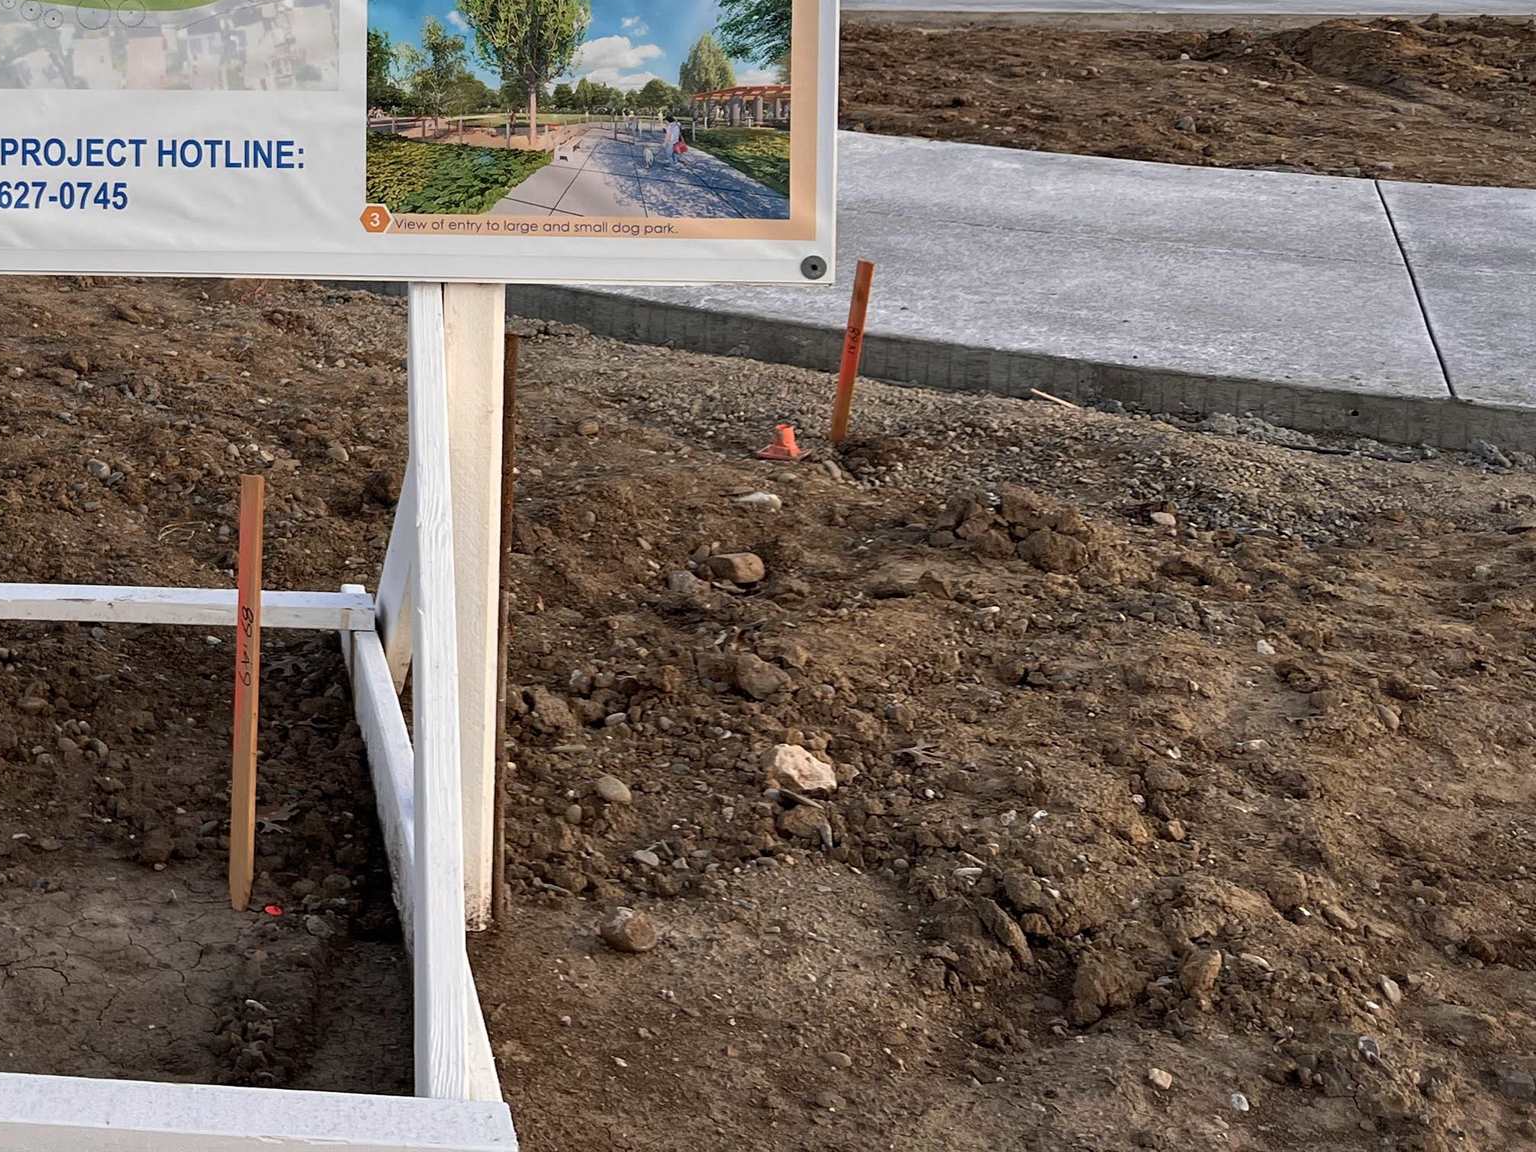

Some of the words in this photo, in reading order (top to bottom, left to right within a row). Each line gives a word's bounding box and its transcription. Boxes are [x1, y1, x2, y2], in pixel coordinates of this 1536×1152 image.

[1, 138, 147, 168] PROJECT
[158, 140, 304, 169] HOTLINE:
[394, 219, 427, 231] View
[430, 219, 445, 231] of
[448, 219, 482, 234] entry
[486, 220, 499, 231] to
[504, 220, 538, 235] large
[543, 220, 571, 232] and
[574, 220, 607, 233] small
[612, 222, 640, 235] dog
[645, 222, 678, 235] park.
